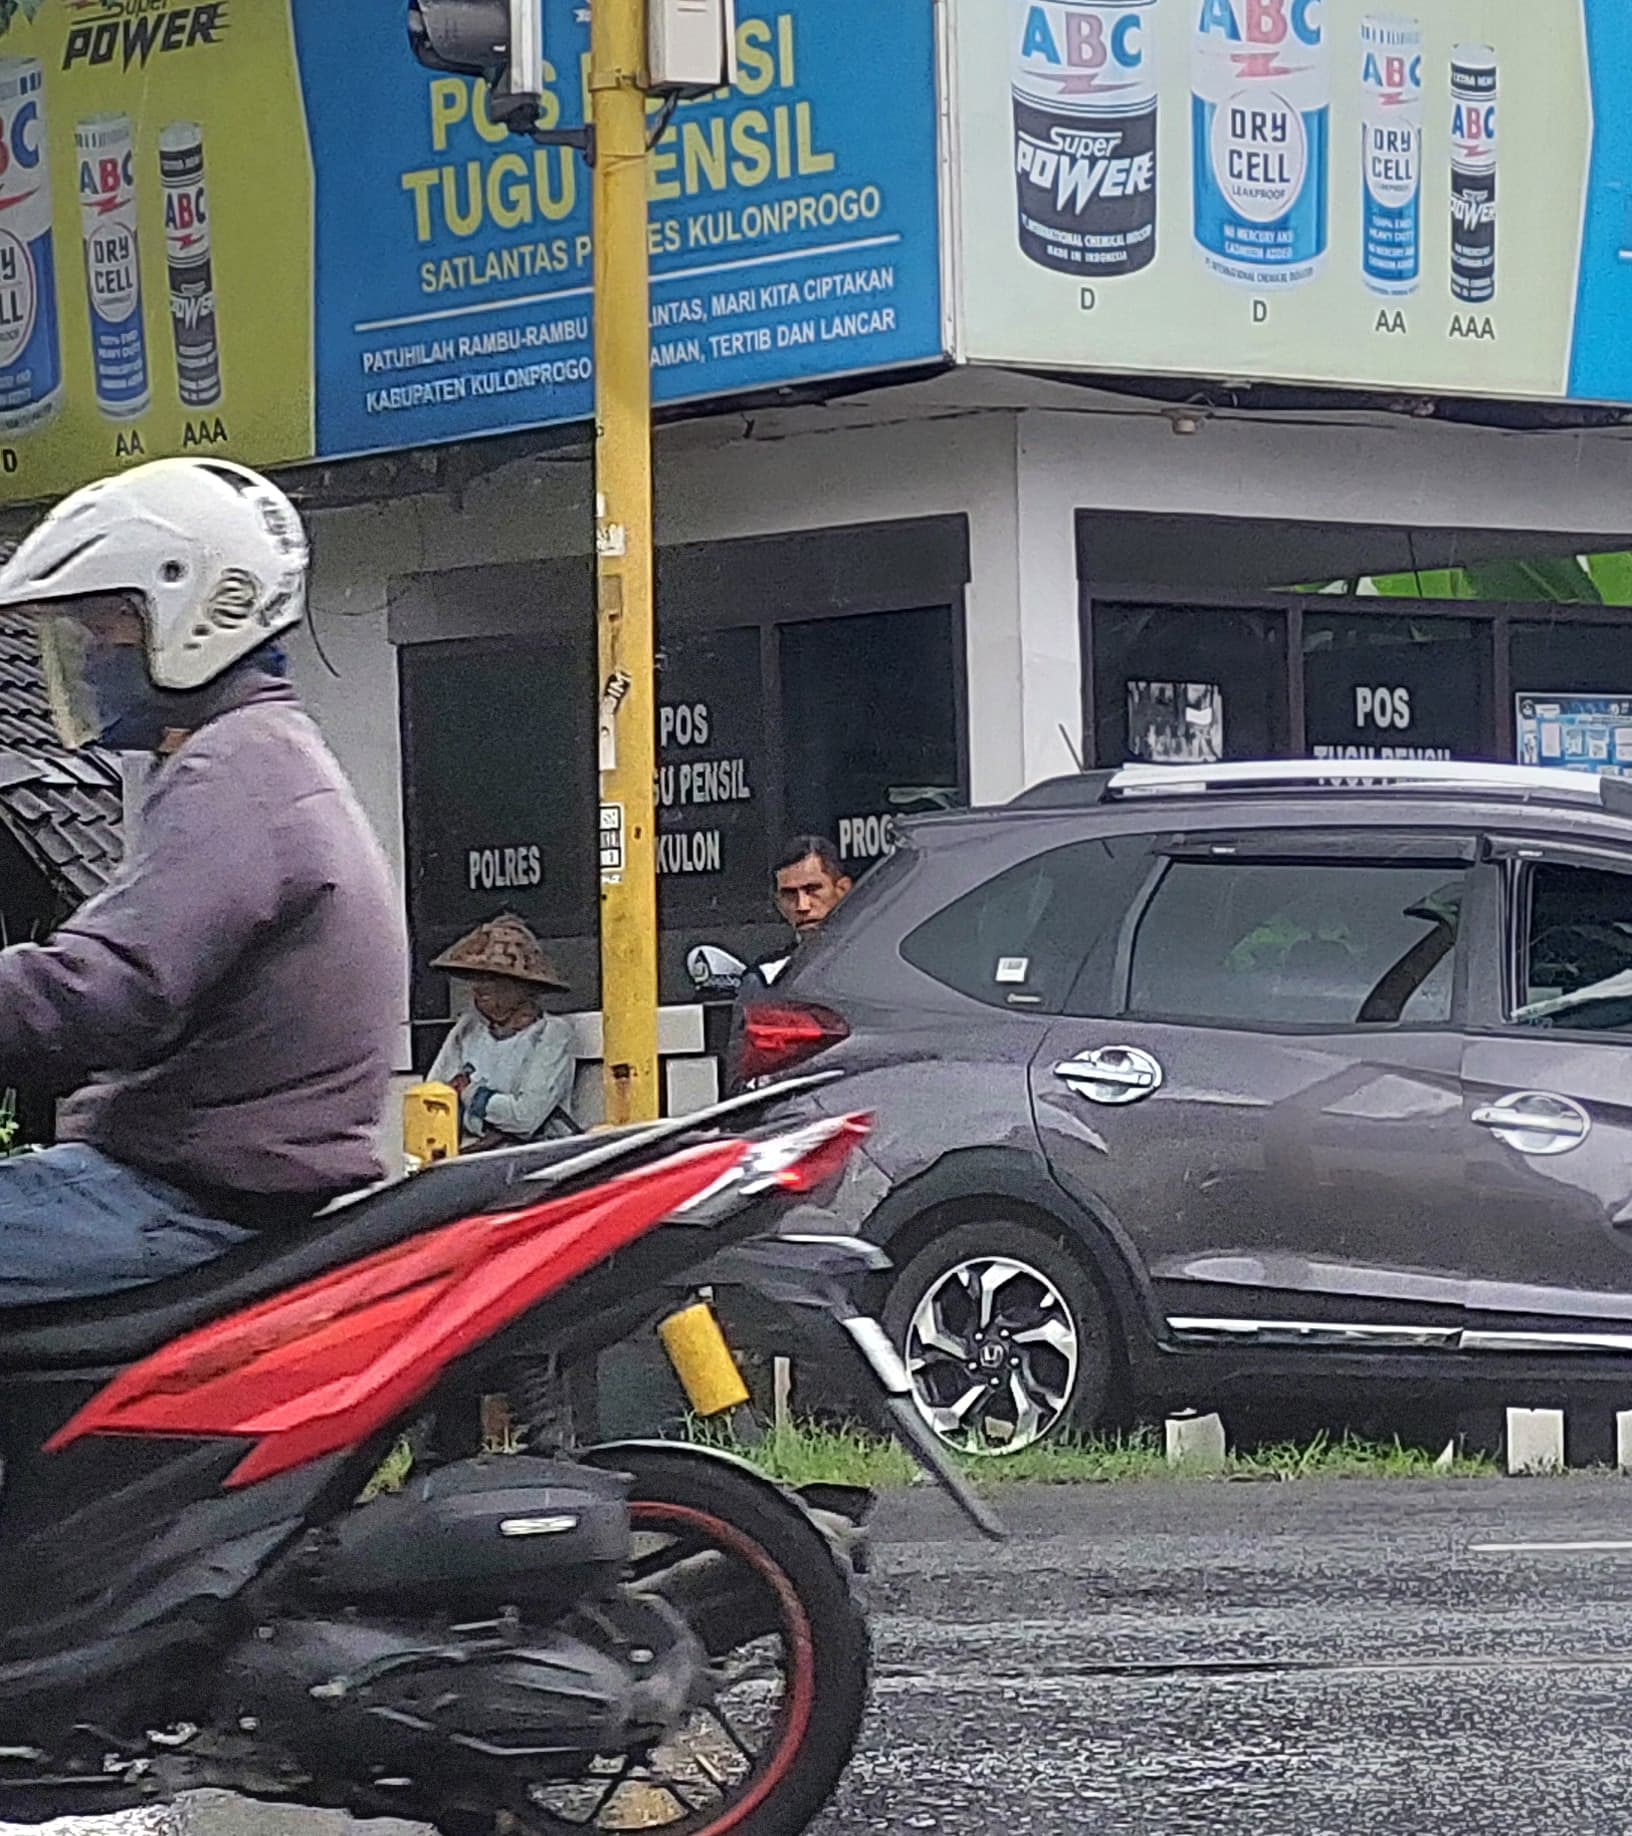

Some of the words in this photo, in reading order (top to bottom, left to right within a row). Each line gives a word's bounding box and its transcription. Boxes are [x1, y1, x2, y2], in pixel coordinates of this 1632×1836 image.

[62, 3, 230, 74] POWER
[1021, 5, 1143, 68] ABC
[1199, 0, 1321, 45] ABC
[1363, 52, 1421, 87] ABC
[1231, 108, 1286, 142] DRY
[1374, 128, 1411, 152] DRY
[1452, 104, 1495, 139] ABC
[1050, 127, 1122, 157] Super
[80, 150, 133, 195] ABC
[402, 147, 576, 241] TUGU
[646, 102, 834, 201] ENSIL
[1017, 151, 1154, 216] POWER
[1229, 149, 1290, 183] CELL
[1372, 156, 1412, 181] CELL
[165, 187, 207, 229] ABC
[94, 236, 129, 264] DRY
[421, 239, 568, 293] SATLANTAS
[688, 186, 880, 247] KULONPROGO
[95, 266, 133, 294] CELL
[1080, 287, 1095, 310] D
[363, 340, 455, 374] PATUHILAH
[458, 317, 588, 354] RAMBU-RAMBU
[648, 299, 707, 328] INTAS,
[712, 291, 756, 317] MARI
[760, 283, 800, 309] KITA
[804, 267, 894, 301] CIPTAKAN
[1252, 300, 1267, 323] D
[1375, 310, 1406, 334] AA
[1449, 315, 1495, 340] AAA
[367, 377, 467, 413] KABUPATEN
[471, 356, 592, 395] KULONPROGO
[649, 340, 706, 367] AMAN,
[708, 328, 771, 358] TERTIB
[777, 321, 815, 348] DAN
[820, 308, 896, 340] LANCAR
[115, 430, 145, 457] AA
[183, 417, 227, 448] AAA
[660, 704, 709, 747] POS
[1356, 687, 1410, 728] POS
[680, 758, 750, 805] PENSIL
[469, 845, 541, 890] POLRES
[657, 829, 721, 874] KULON
